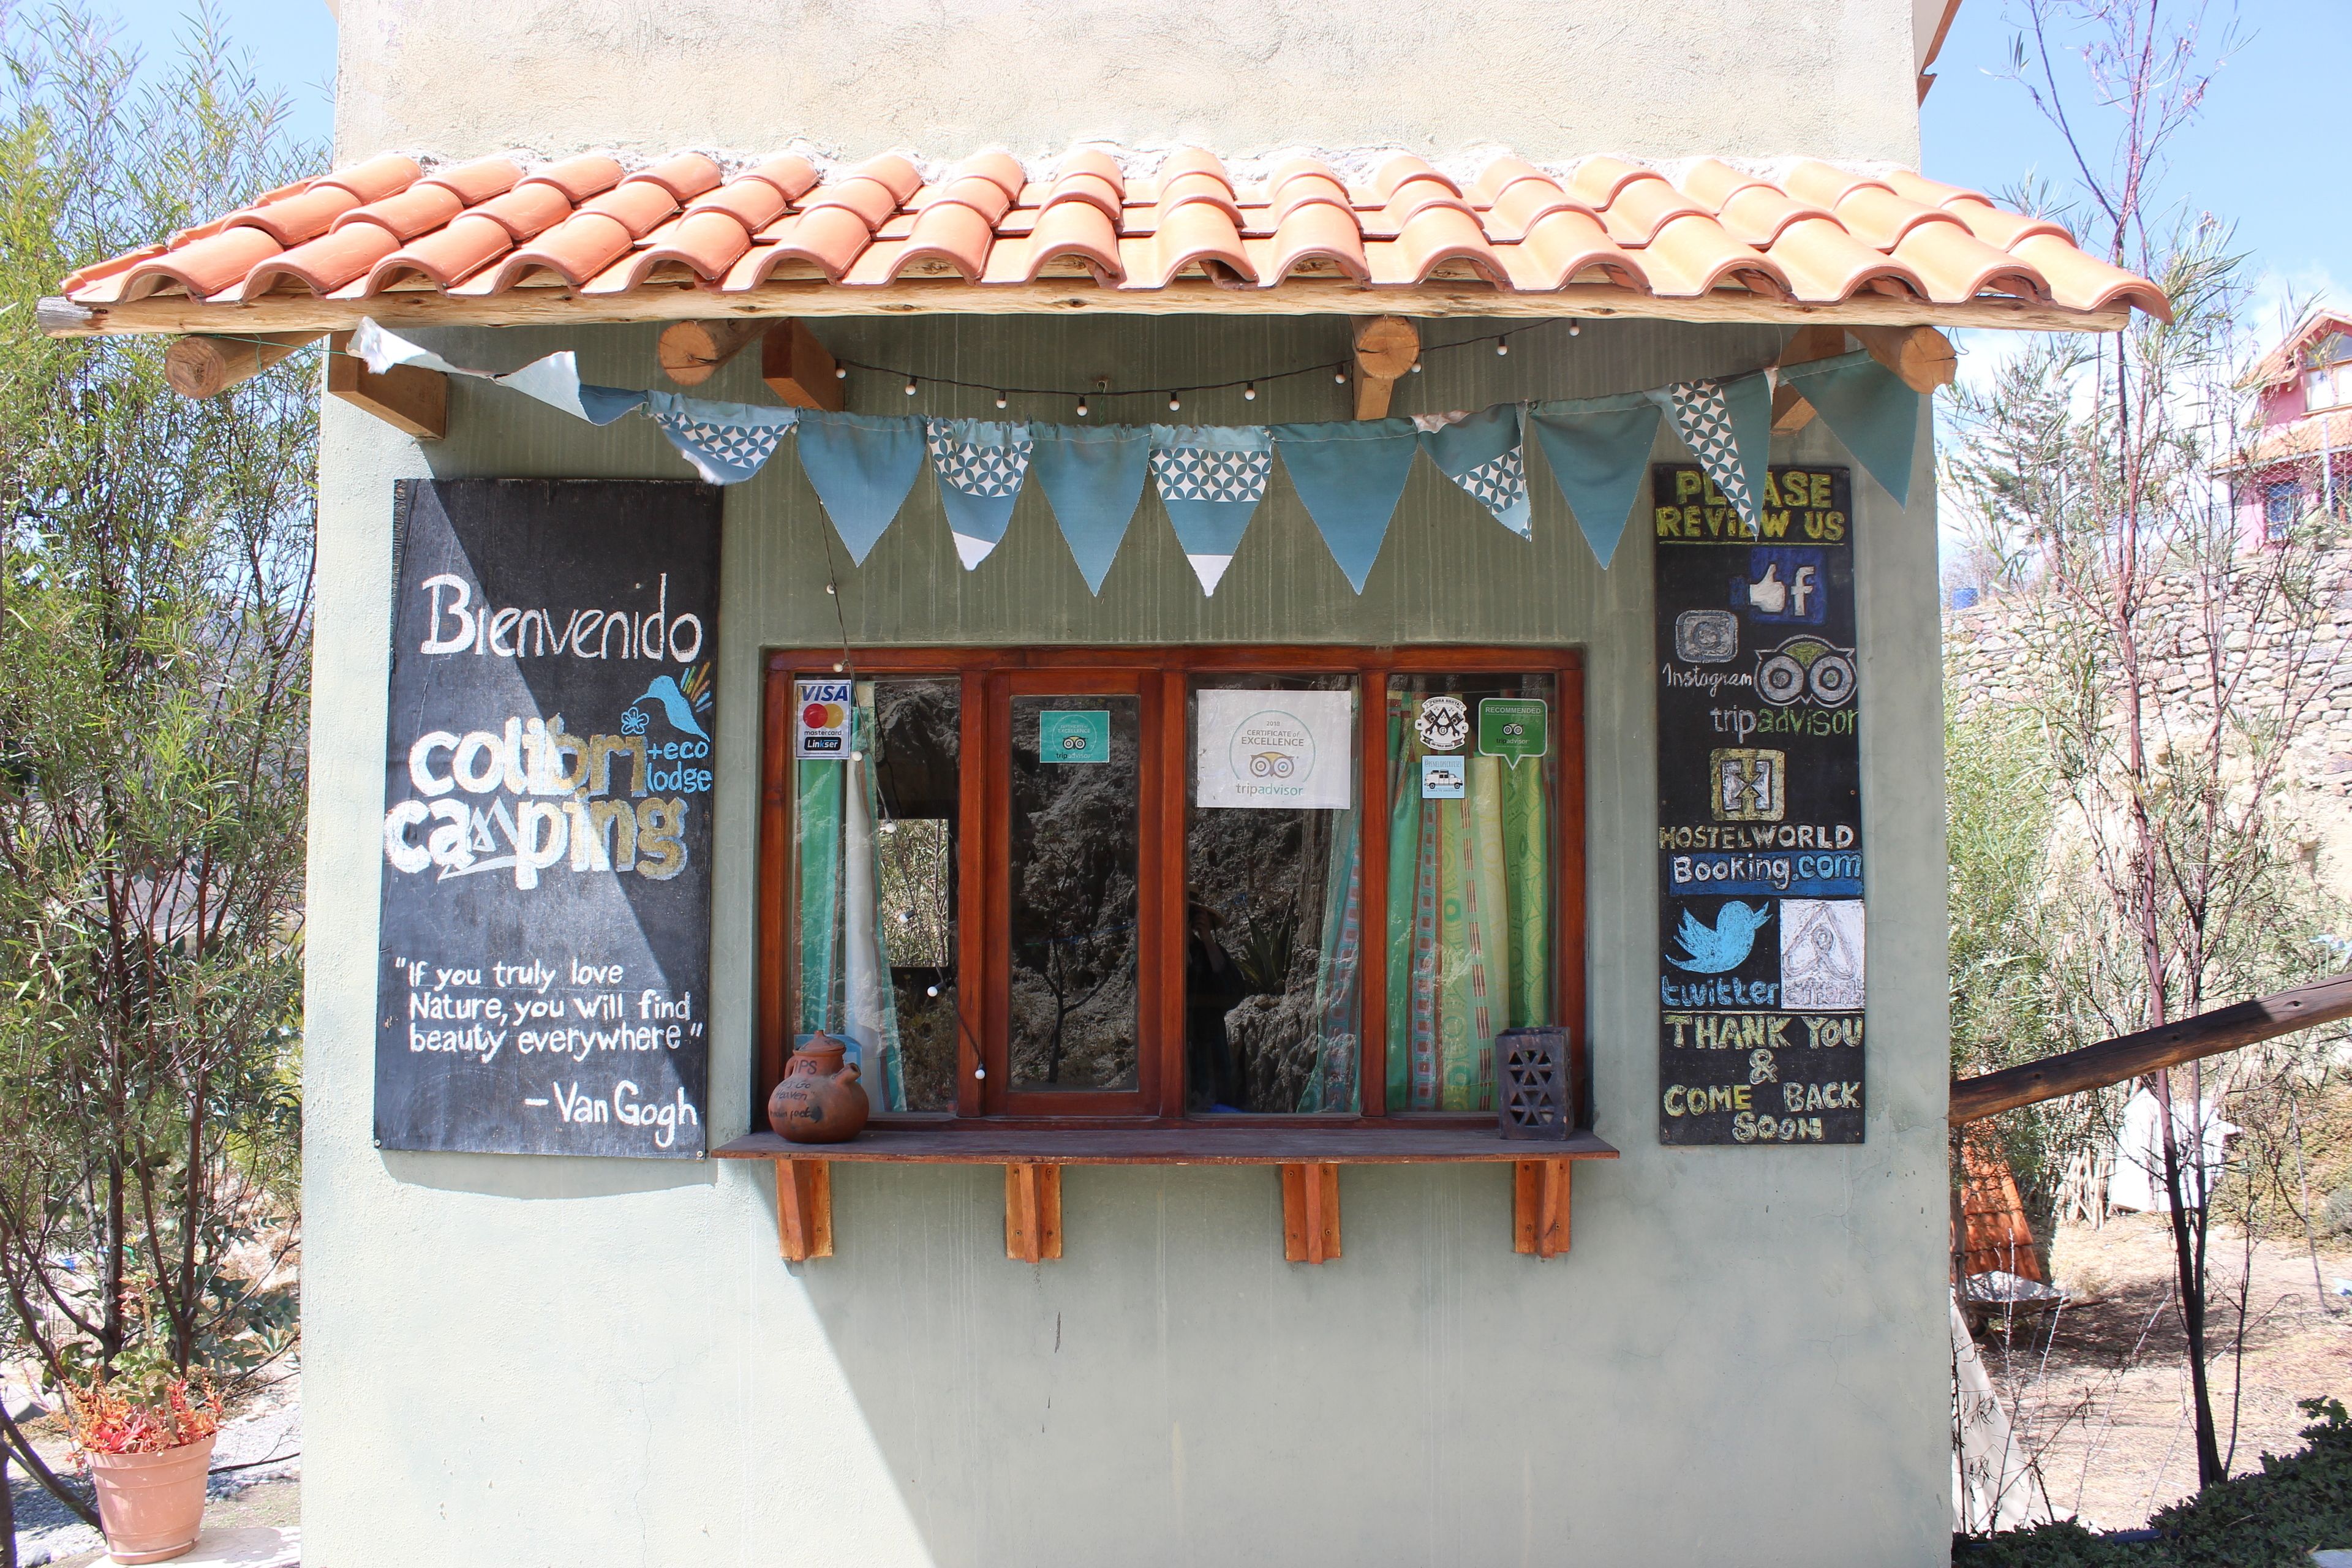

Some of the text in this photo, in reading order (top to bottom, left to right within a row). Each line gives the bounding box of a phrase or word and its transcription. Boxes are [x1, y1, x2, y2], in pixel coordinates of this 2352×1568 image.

[1676, 471, 1832, 508] PLASE
[1804, 511, 1845, 541] US
[421, 573, 703, 662] Bienvenido
[799, 685, 848, 701] VISA
[1662, 662, 1753, 697] Instagram
[1241, 737, 1304, 747] EXCELLENCE
[1709, 705, 1859, 744] tripadvisor
[409, 713, 648, 796] colibri
[807, 739, 838, 748] Linkser
[646, 761, 713, 793] lodge
[1236, 782, 1303, 796] tripadvisor
[1658, 824, 1854, 850] HOSTELWORLD
[1673, 853, 1863, 890] Booking.com
[435, 967, 481, 991] you
[493, 959, 556, 993] truly
[572, 959, 624, 985] love
[1661, 975, 1778, 1006] twitter
[409, 989, 691, 1028] Nature, you will find
[409, 1022, 506, 1064] beauty
[1664, 1014, 1863, 1050] THANK YOU
[1748, 1049, 1777, 1084] &
[614, 1079, 698, 1148] Gogh
[1663, 1081, 1862, 1117] COME BACK
[1732, 1111, 1825, 1142] SOON
